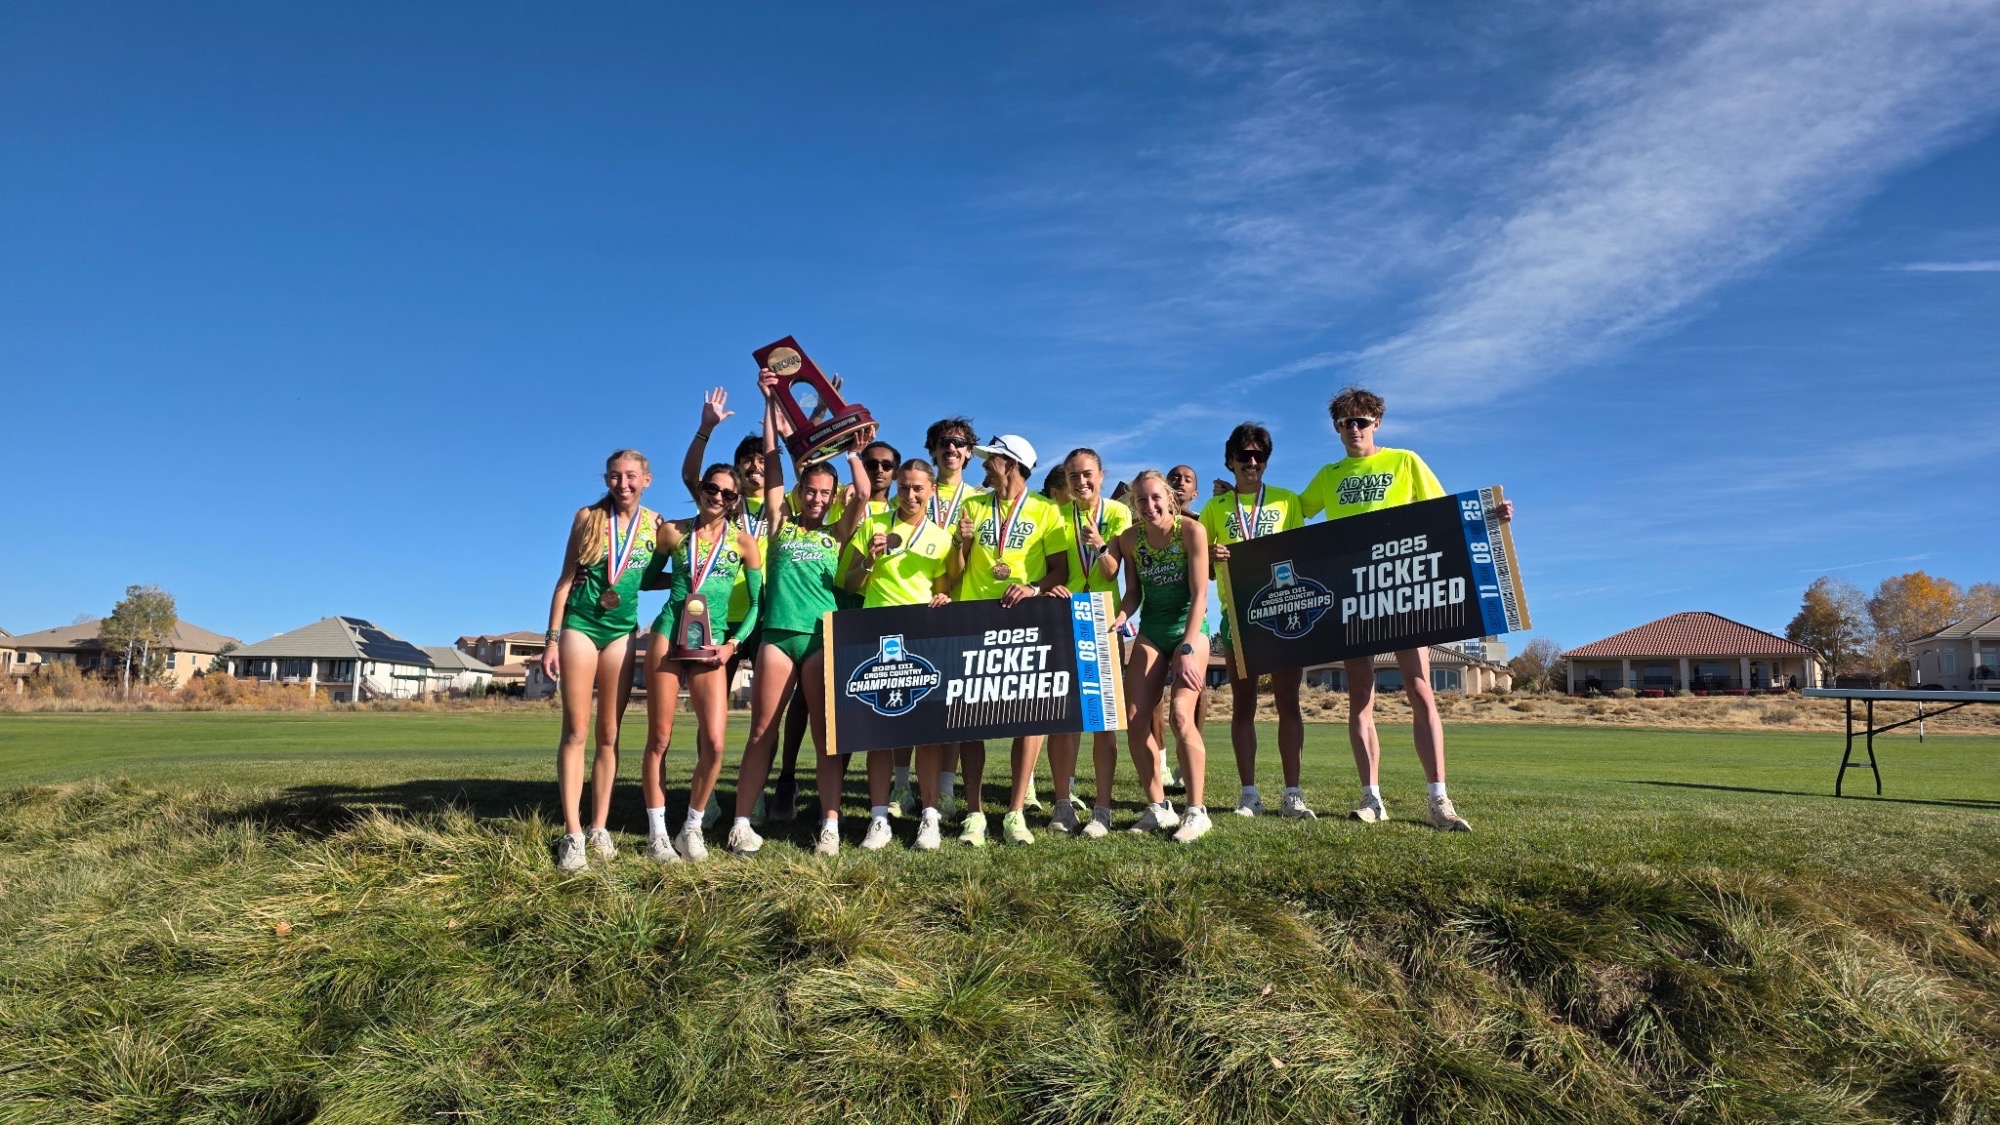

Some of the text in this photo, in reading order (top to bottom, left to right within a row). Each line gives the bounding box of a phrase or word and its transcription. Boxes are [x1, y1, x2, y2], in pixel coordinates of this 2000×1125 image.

[809, 416, 857, 442] REGIONAL CHAMPION
[1336, 474, 1393, 493] ADAMS
[1340, 488, 1386, 505] STATE
[1461, 500, 1482, 521] 25
[780, 539, 819, 551] Adams
[1371, 534, 1428, 560] 2025
[1470, 542, 1492, 564] 08
[627, 559, 648, 569] tate
[792, 549, 824, 562] State
[1140, 562, 1176, 577] Adams
[1352, 551, 1443, 593] TICKET
[1153, 573, 1185, 586] State
[1261, 590, 1315, 607] CROSS COUNTRY
[1268, 586, 1307, 599] 2025 DII
[1342, 576, 1466, 624] PUNCHED
[1479, 584, 1499, 598] 11
[1250, 595, 1331, 620] CHAMPIONSHIPS
[984, 627, 1039, 646] 2025
[872, 664, 897, 673] 2025
[962, 645, 1052, 676] TICKET
[1074, 600, 1100, 726] SECTION 11 ROW 08 SEAT 25
[849, 674, 938, 693] CHAMPIONSHIPS
[863, 668, 922, 680] CROSS COUNTRY
[946, 671, 1070, 705] PUNCHED
